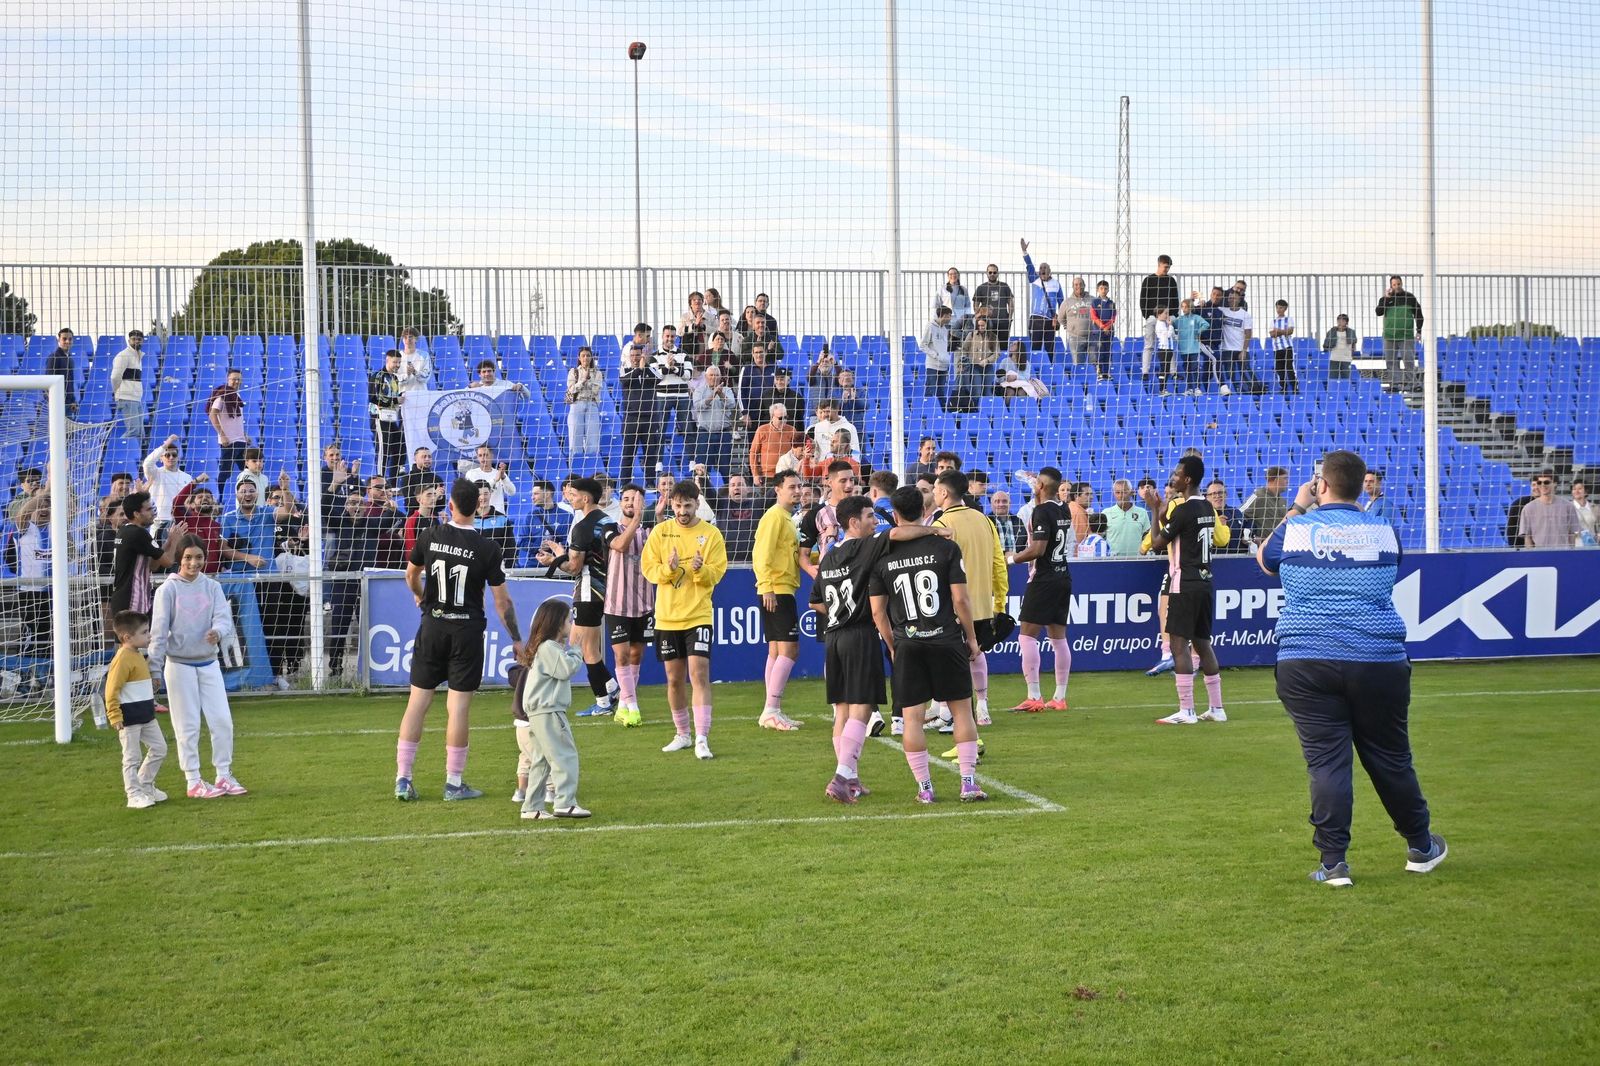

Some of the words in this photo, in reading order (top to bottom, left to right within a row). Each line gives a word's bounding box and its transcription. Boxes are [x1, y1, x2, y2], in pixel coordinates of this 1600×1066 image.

[429, 542, 462, 557] BOLLULLOS
[887, 556, 923, 571] BOLLULLOS
[924, 554, 937, 565] C.F.
[431, 559, 468, 607] 11
[825, 578, 857, 628] 21
[893, 569, 940, 621] 18
[695, 627, 710, 642] 10
[1072, 635, 1099, 650] del
[1103, 637, 1152, 656] grupo
